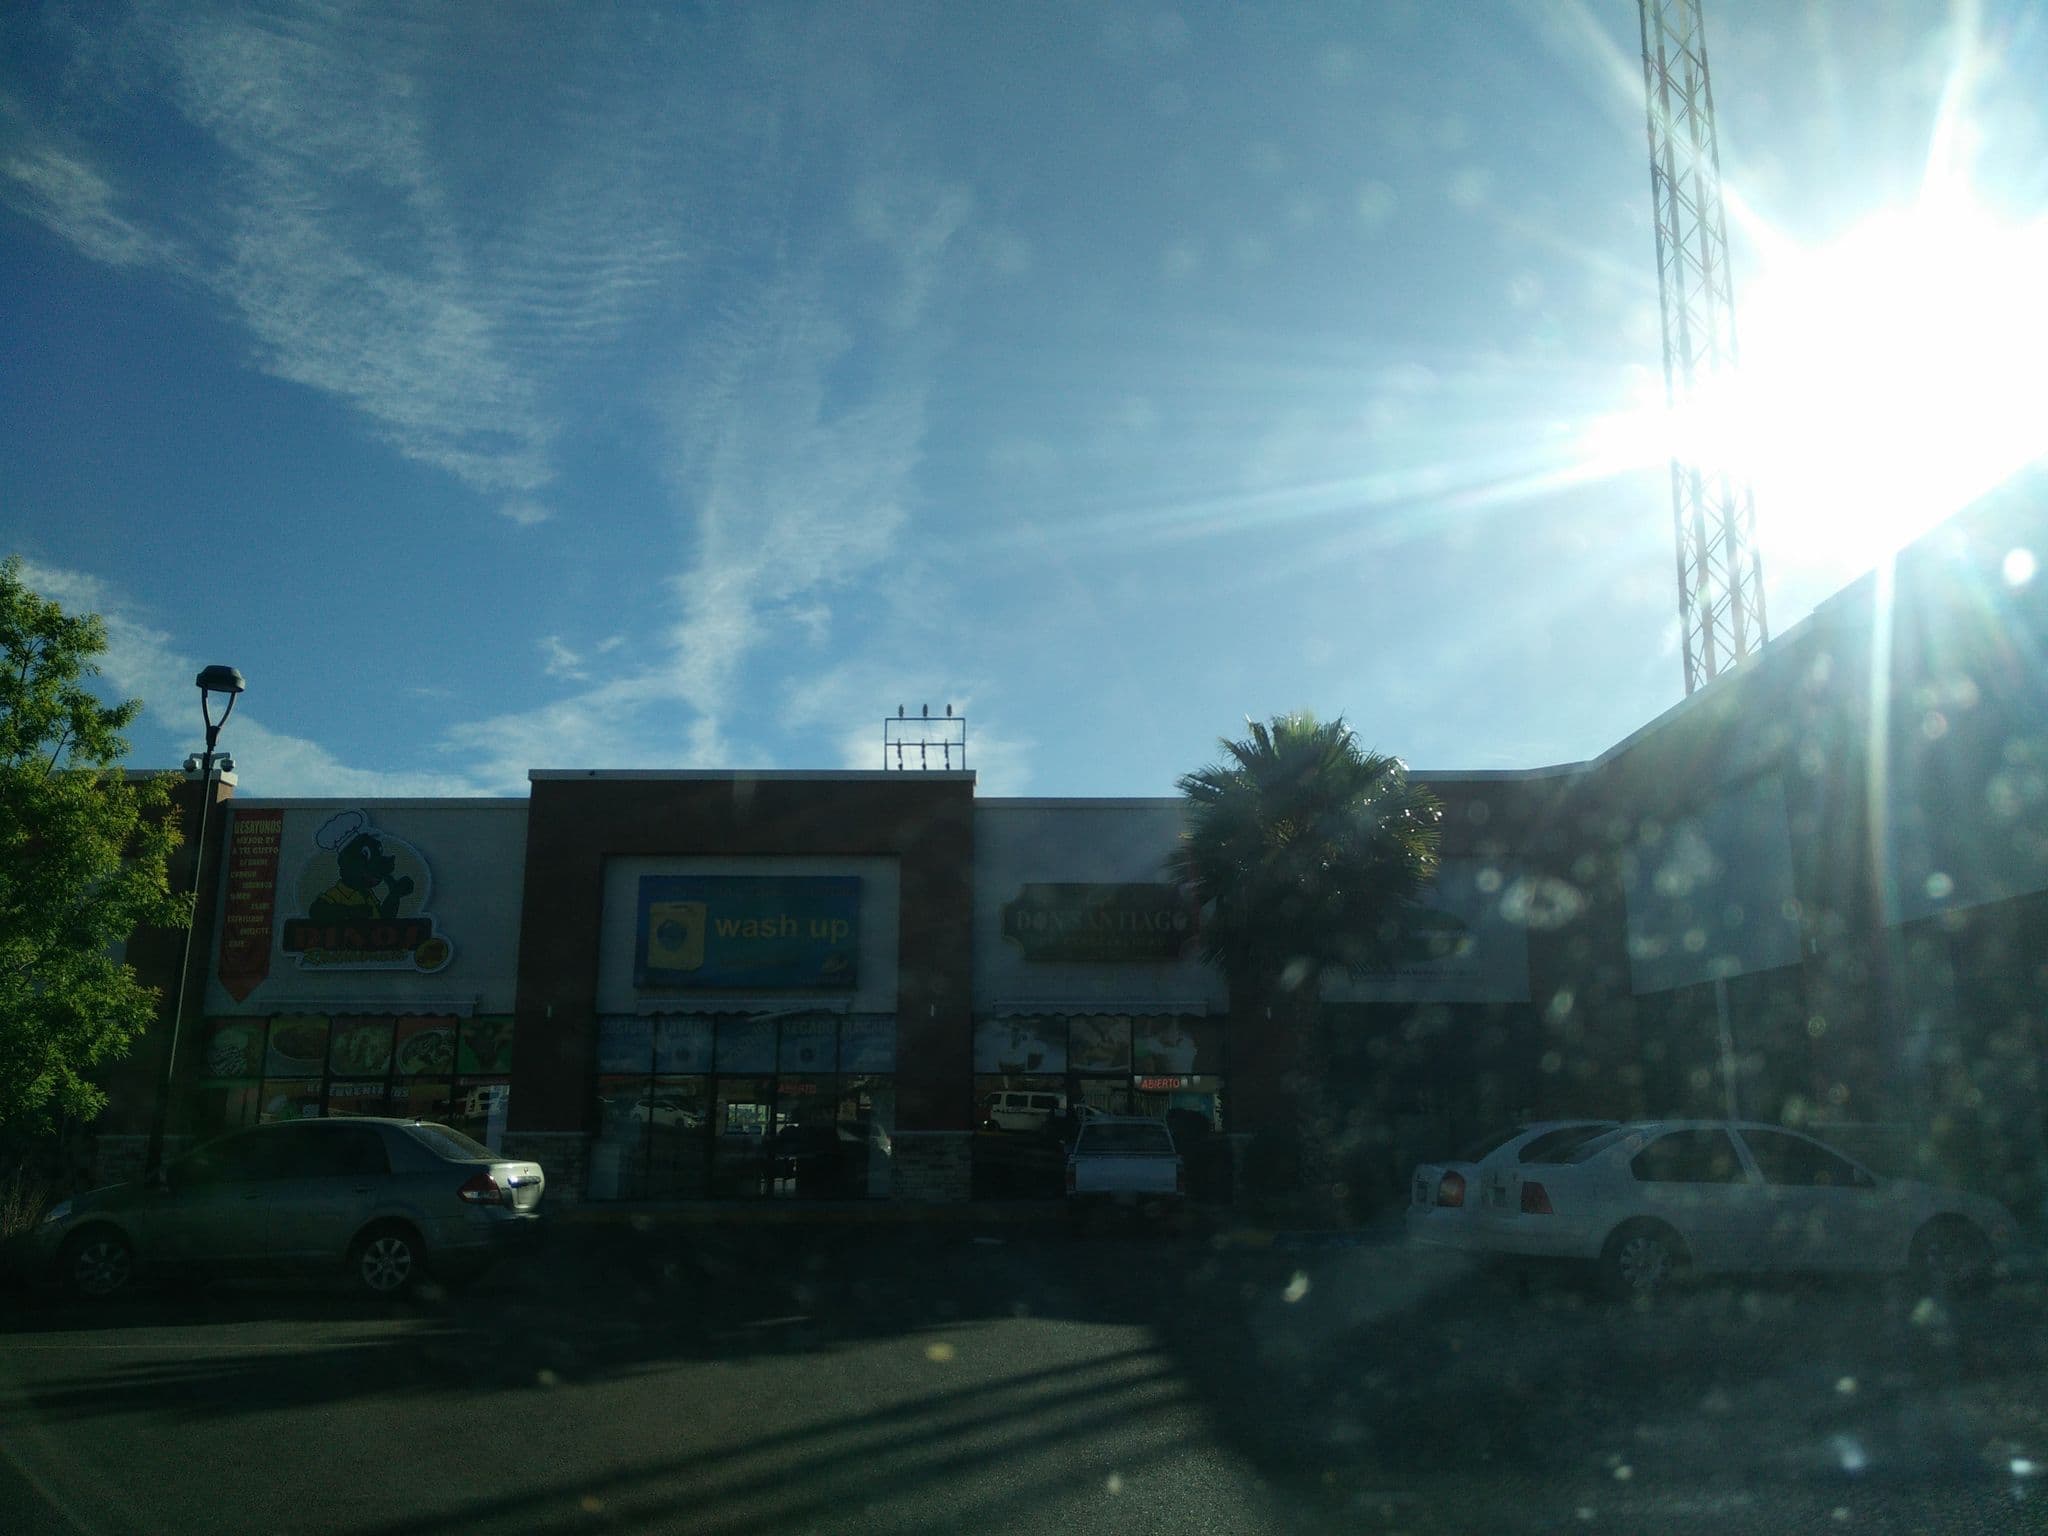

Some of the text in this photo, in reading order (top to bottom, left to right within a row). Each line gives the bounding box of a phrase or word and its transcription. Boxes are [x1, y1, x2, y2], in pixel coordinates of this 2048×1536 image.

[234, 819, 281, 834] DESAYUNOS
[715, 913, 850, 945] wash up
[1141, 1078, 1180, 1089] ABIERTO
